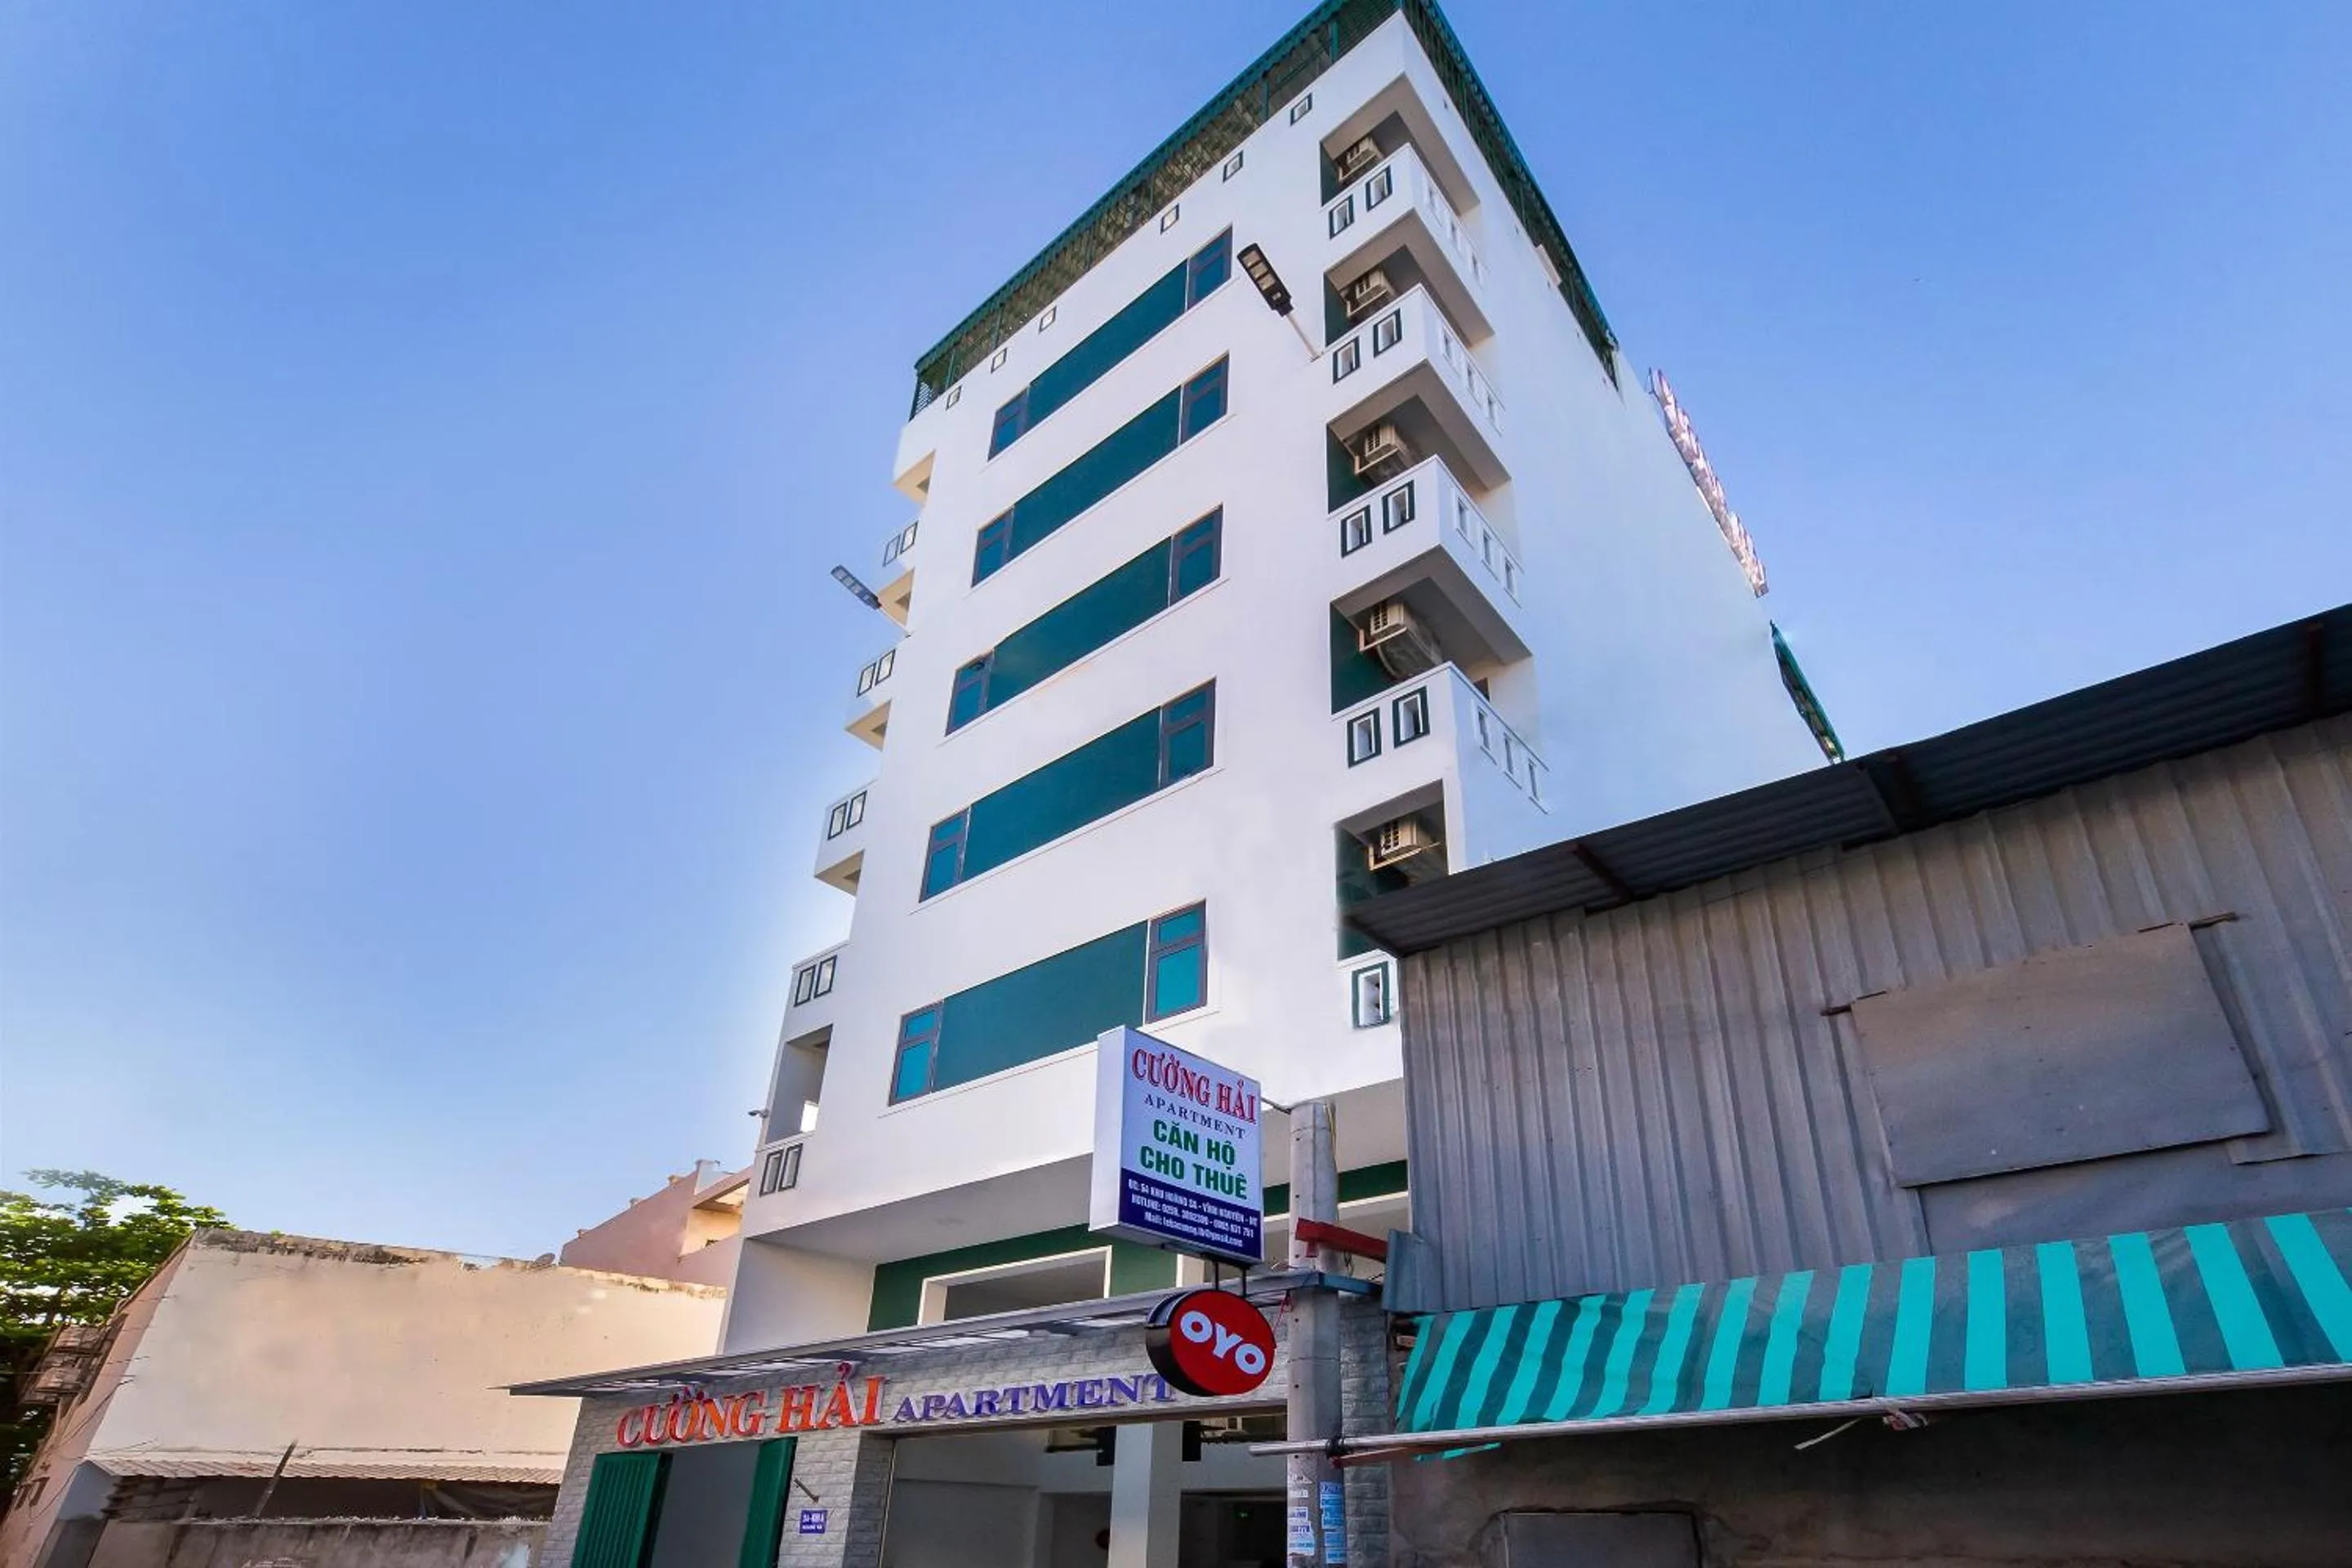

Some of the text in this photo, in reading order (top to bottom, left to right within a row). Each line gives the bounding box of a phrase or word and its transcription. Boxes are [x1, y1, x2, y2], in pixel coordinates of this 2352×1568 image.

[1144, 1094, 1245, 1138] APARTMENT
[1215, 1078, 1257, 1125] HẢI
[1153, 1119, 1235, 1170] CĂN HỘ
[1140, 1146, 1248, 1200] CHO THUÊ
[1180, 1311, 1266, 1374] OYO
[775, 1360, 887, 1433] HẢI
[892, 1373, 1175, 1423] APARTMENT
